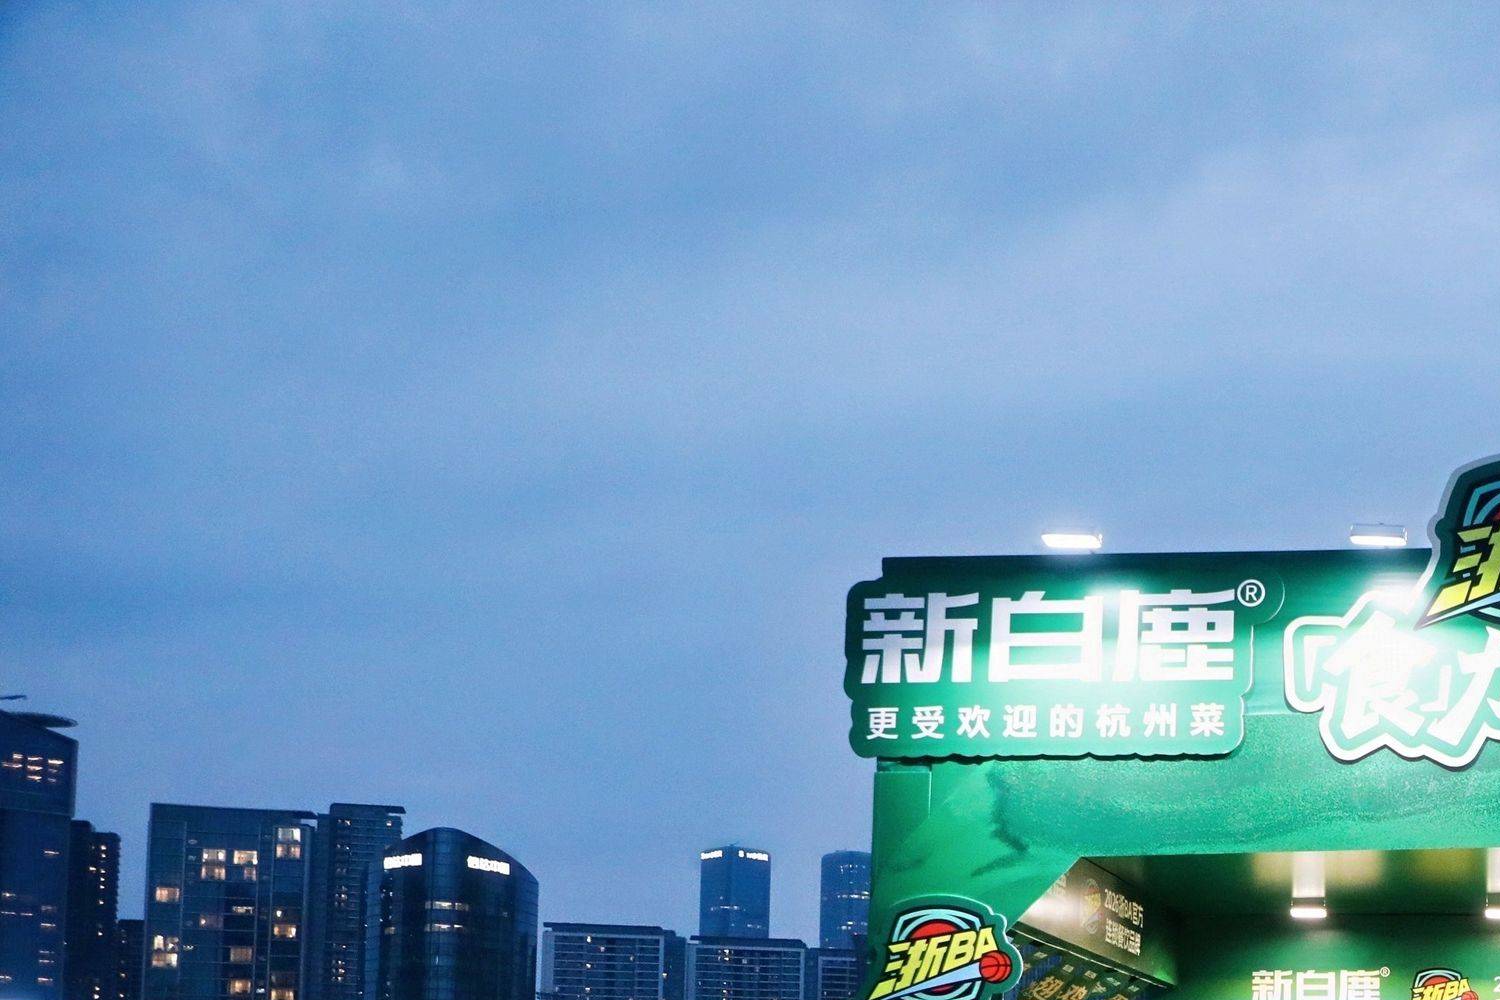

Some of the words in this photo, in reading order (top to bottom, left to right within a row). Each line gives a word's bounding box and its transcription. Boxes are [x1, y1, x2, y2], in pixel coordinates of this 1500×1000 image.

[866, 703, 1225, 740] 更受欢迎的杭州菜
